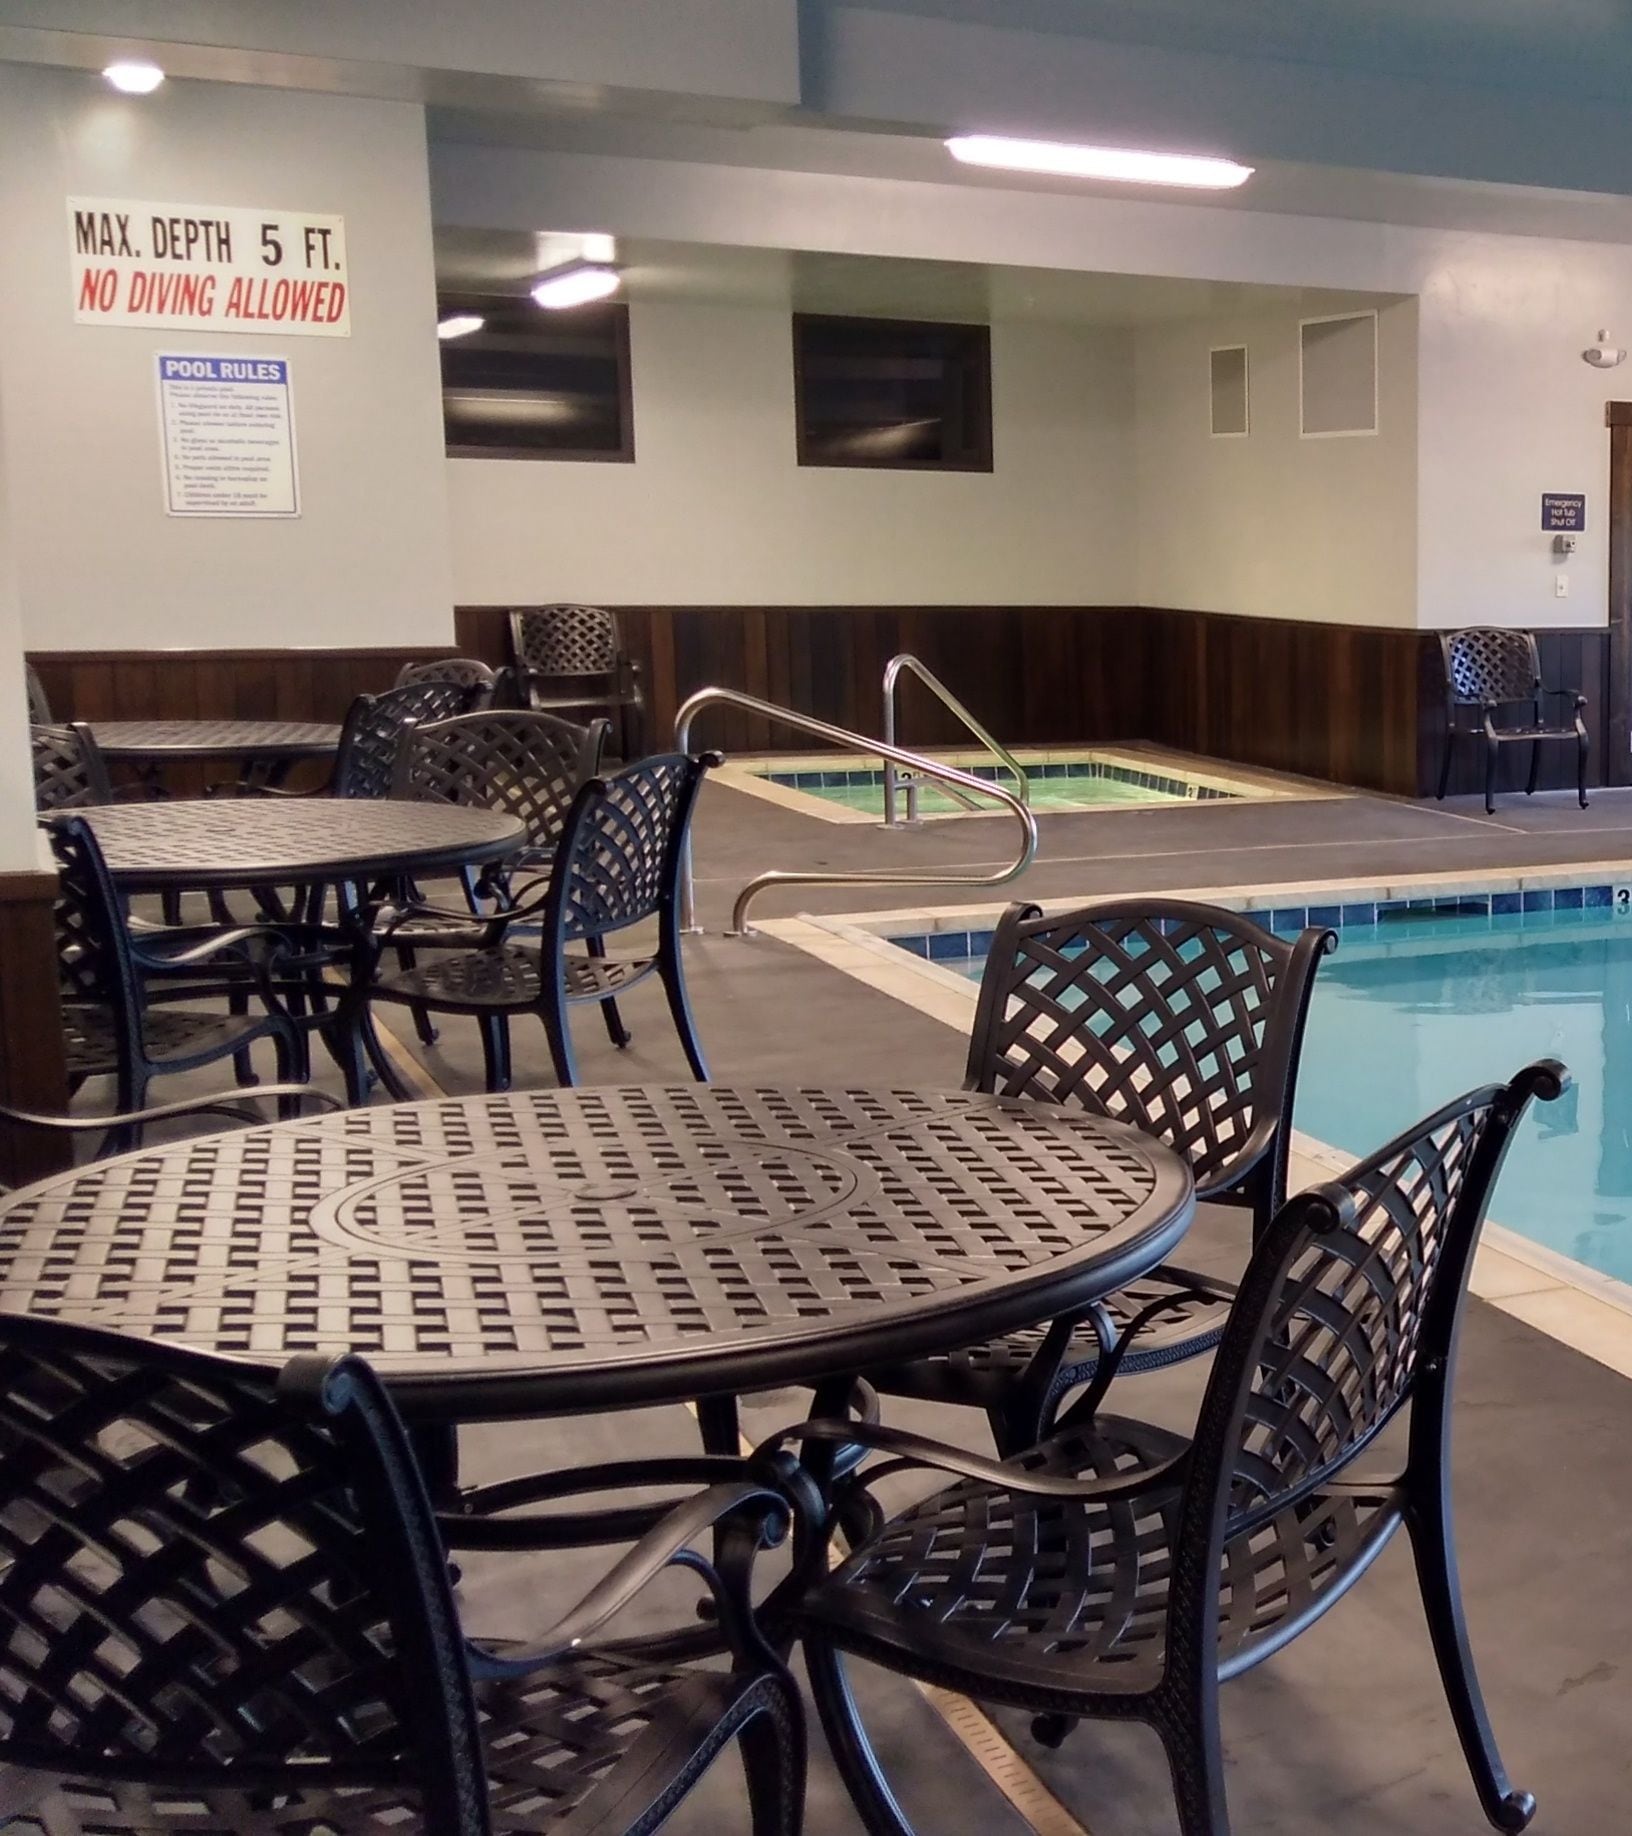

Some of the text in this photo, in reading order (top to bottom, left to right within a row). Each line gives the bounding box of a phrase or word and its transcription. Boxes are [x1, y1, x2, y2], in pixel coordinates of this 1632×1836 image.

[74, 210, 341, 271] MAX. DEPTH 5 FT.
[78, 267, 346, 324] NO DIVING ALLOWED
[165, 360, 281, 381] POOL RULES
[1544, 498, 1583, 509] Emergency
[1551, 508, 1576, 517] Hot Tub
